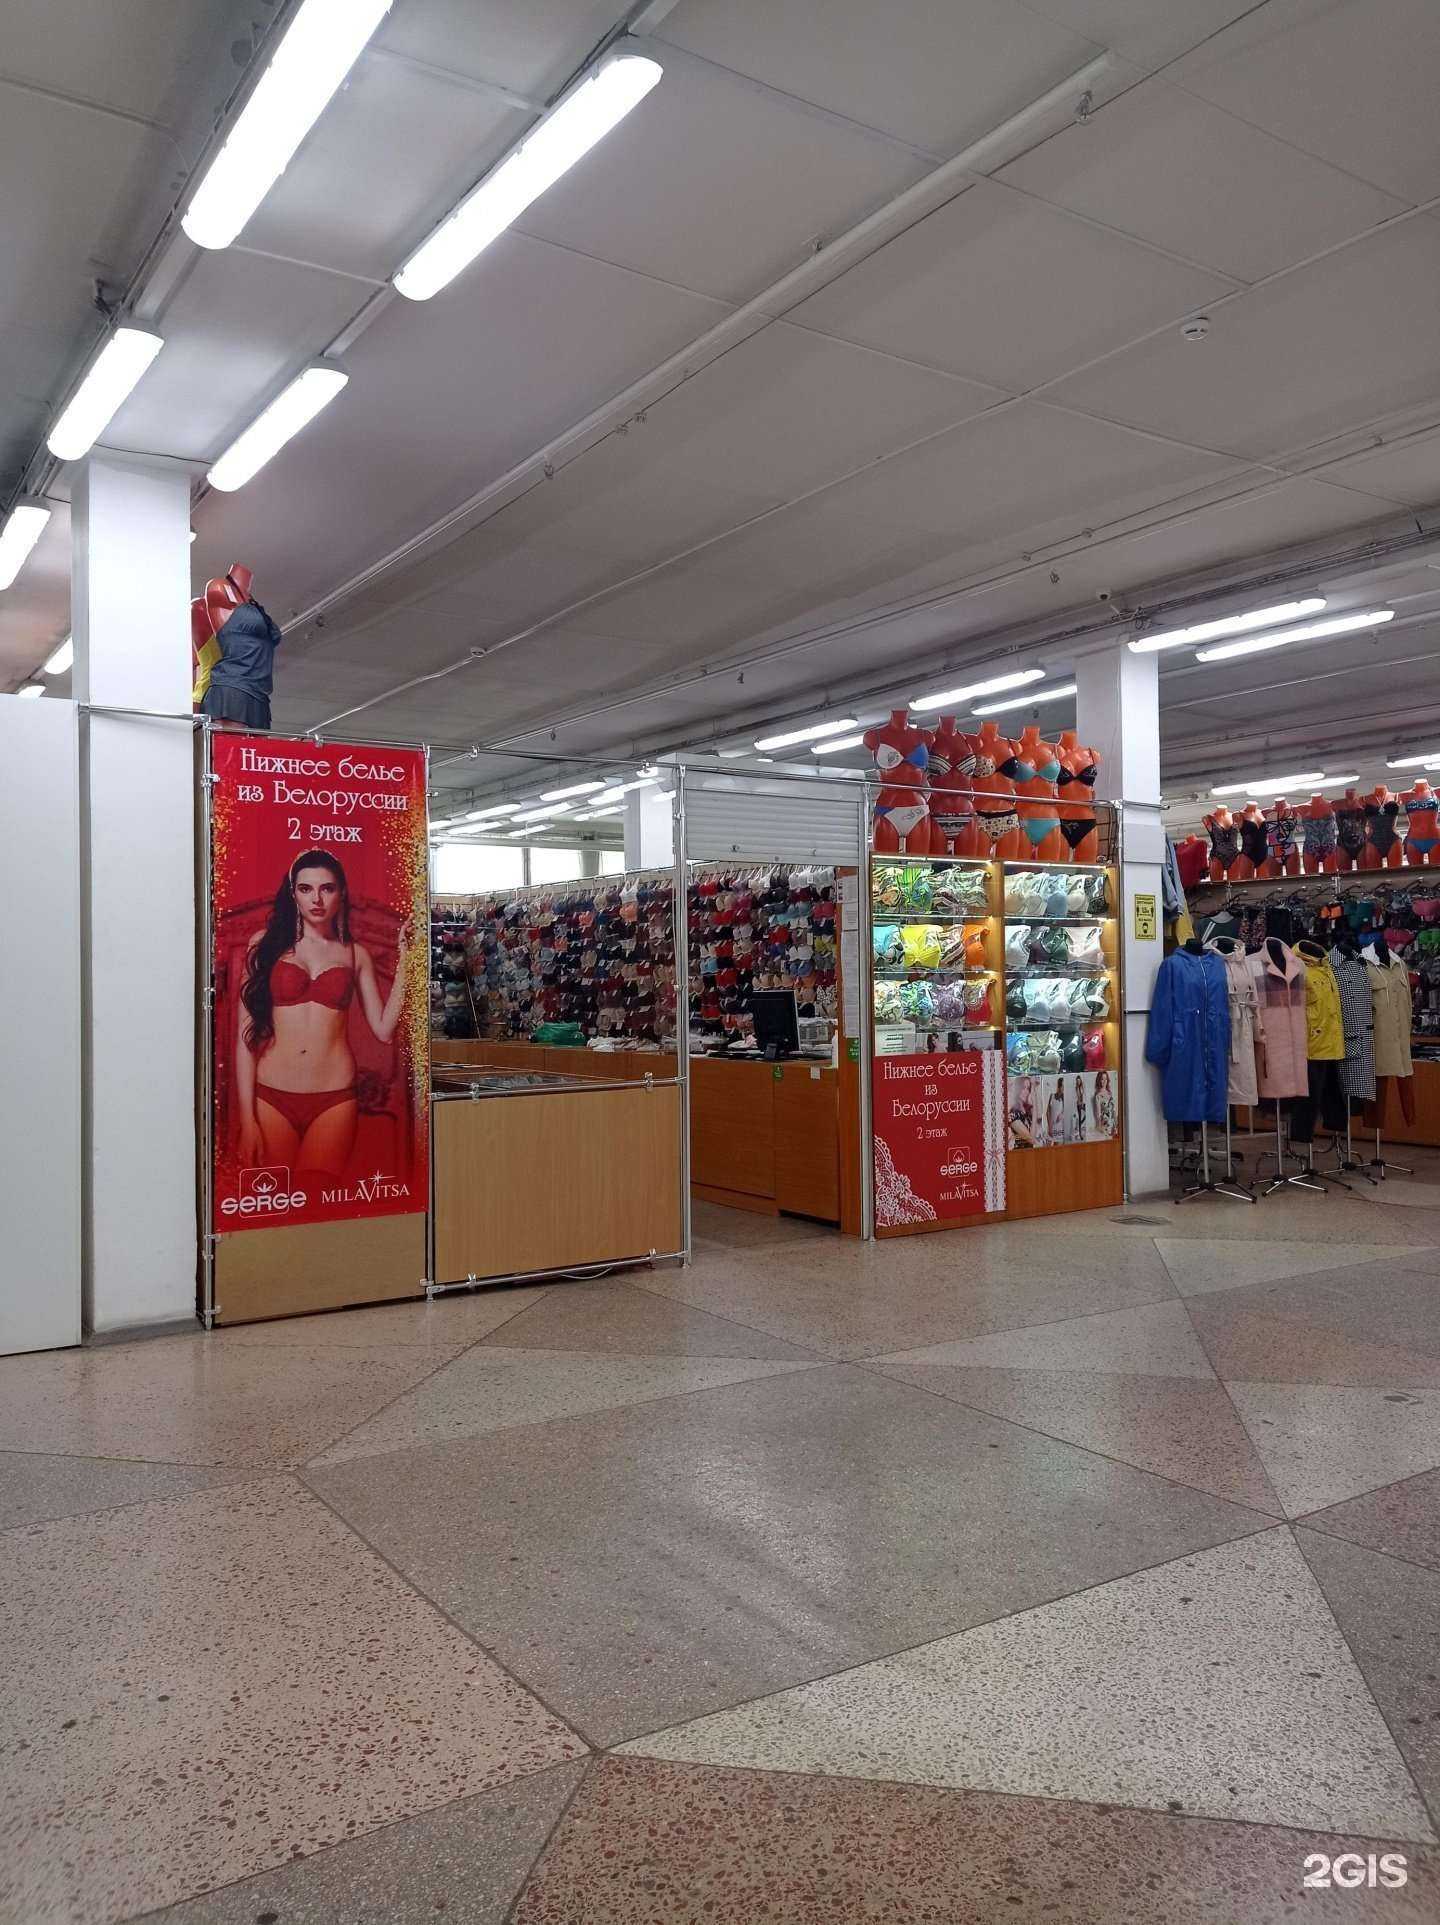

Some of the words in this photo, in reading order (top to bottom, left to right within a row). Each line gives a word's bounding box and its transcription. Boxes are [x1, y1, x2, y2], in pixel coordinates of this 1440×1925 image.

[240, 747, 331, 776] Нижнее
[338, 755, 405, 781] белье
[237, 784, 264, 802] из
[273, 780, 408, 815] Белоруссии
[288, 818, 302, 840] 2
[309, 824, 363, 843] этаж
[883, 1061, 935, 1080] Нижнее
[937, 1058, 978, 1077] белье
[925, 1084, 938, 1096] из
[892, 1099, 970, 1121] Белоруссии
[916, 1126, 924, 1140] 2
[925, 1127, 948, 1139] этаж
